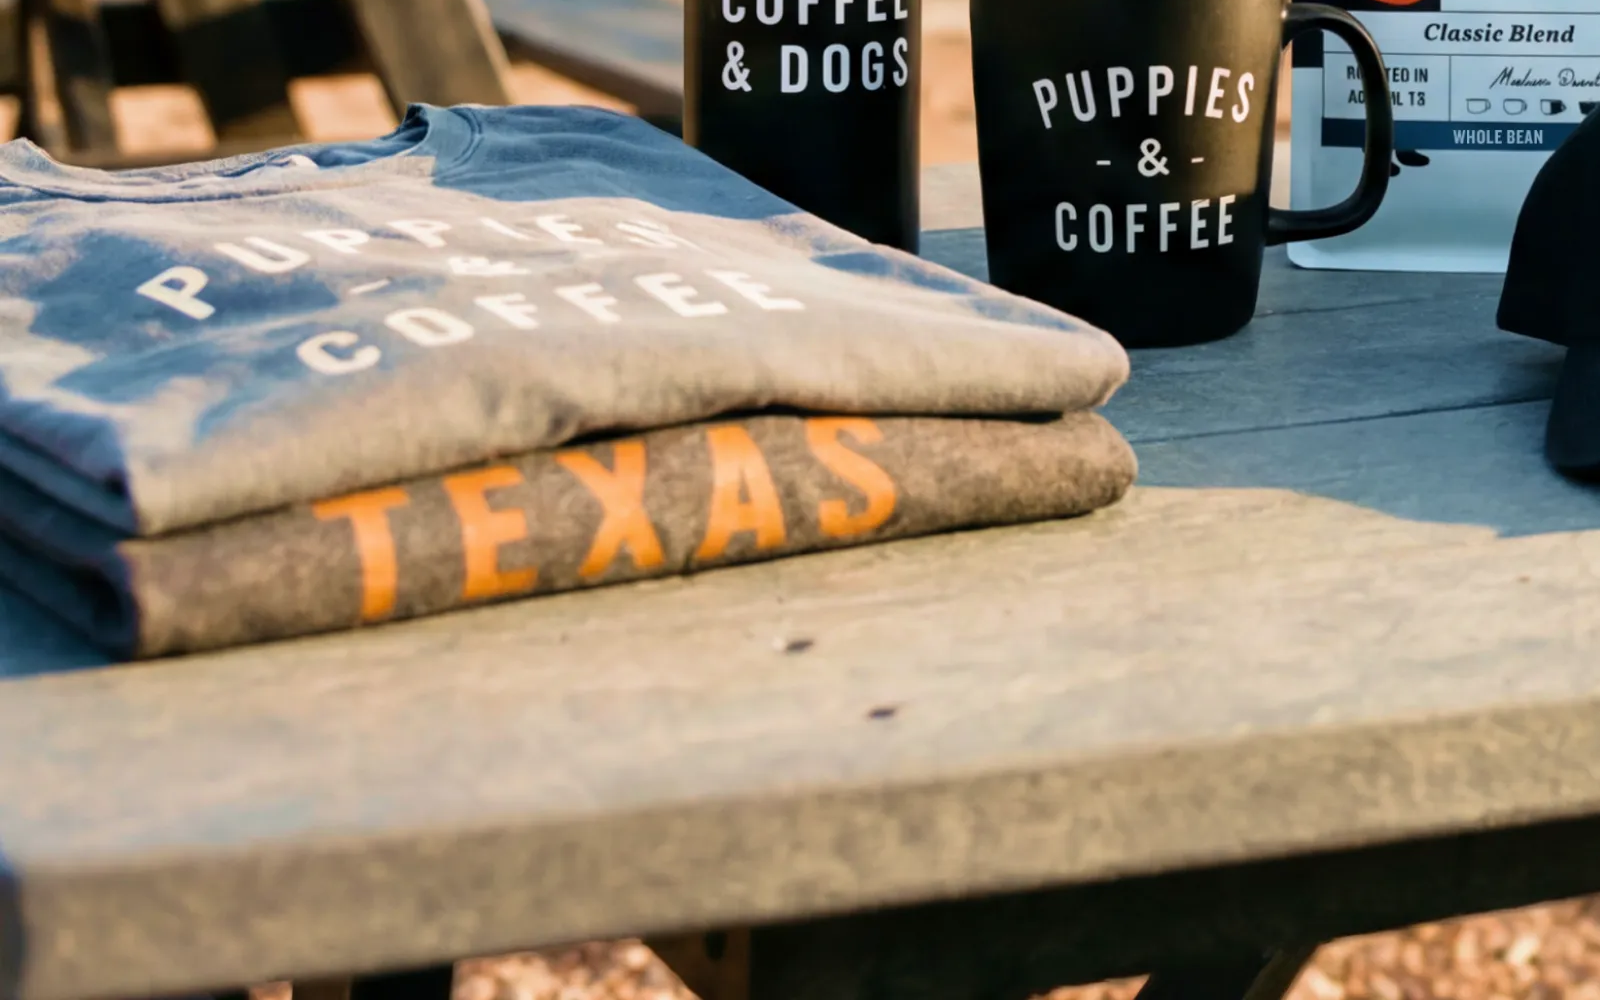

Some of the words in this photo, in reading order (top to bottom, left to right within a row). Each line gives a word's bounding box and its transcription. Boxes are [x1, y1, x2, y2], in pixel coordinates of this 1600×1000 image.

[1424, 23, 1504, 42] Classic
[1508, 24, 1575, 43] Blend
[721, 40, 753, 93] &
[780, 36, 909, 94] DOGS
[1414, 68, 1428, 83] IN
[1032, 62, 1258, 132] PUPPIES
[1137, 138, 1170, 178] &
[1452, 129, 1503, 145] WHOLE
[1506, 129, 1543, 145] BEAN
[1055, 192, 1237, 253] COFFEE
[136, 213, 692, 321] PUPPIES
[296, 269, 806, 375] COFFEE
[313, 418, 899, 621] TEXAS
